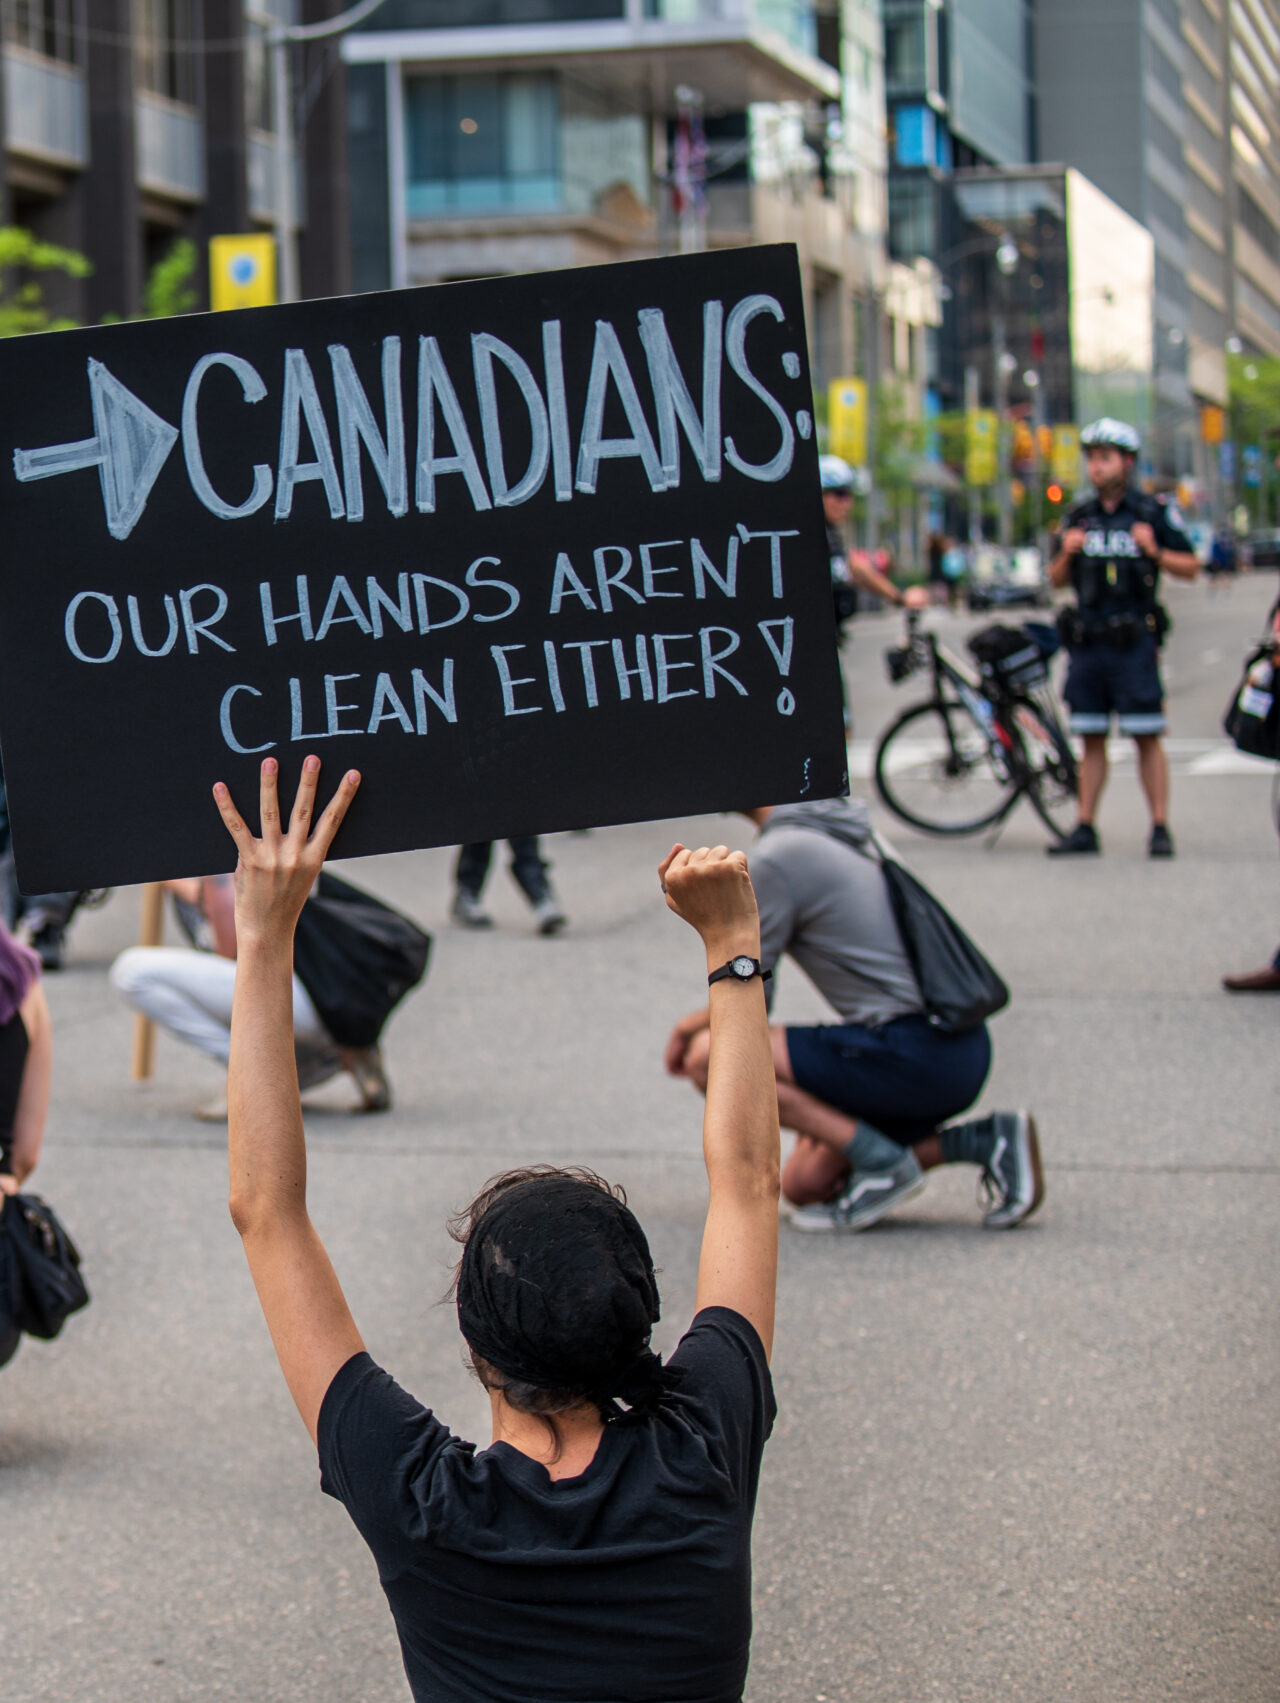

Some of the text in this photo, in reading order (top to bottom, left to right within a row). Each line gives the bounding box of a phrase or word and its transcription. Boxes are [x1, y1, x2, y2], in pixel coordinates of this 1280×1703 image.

[182, 295, 808, 521] CANADIANS:
[65, 524, 799, 663] OUR HANDS AREN'T
[220, 659, 458, 753] CLEAN
